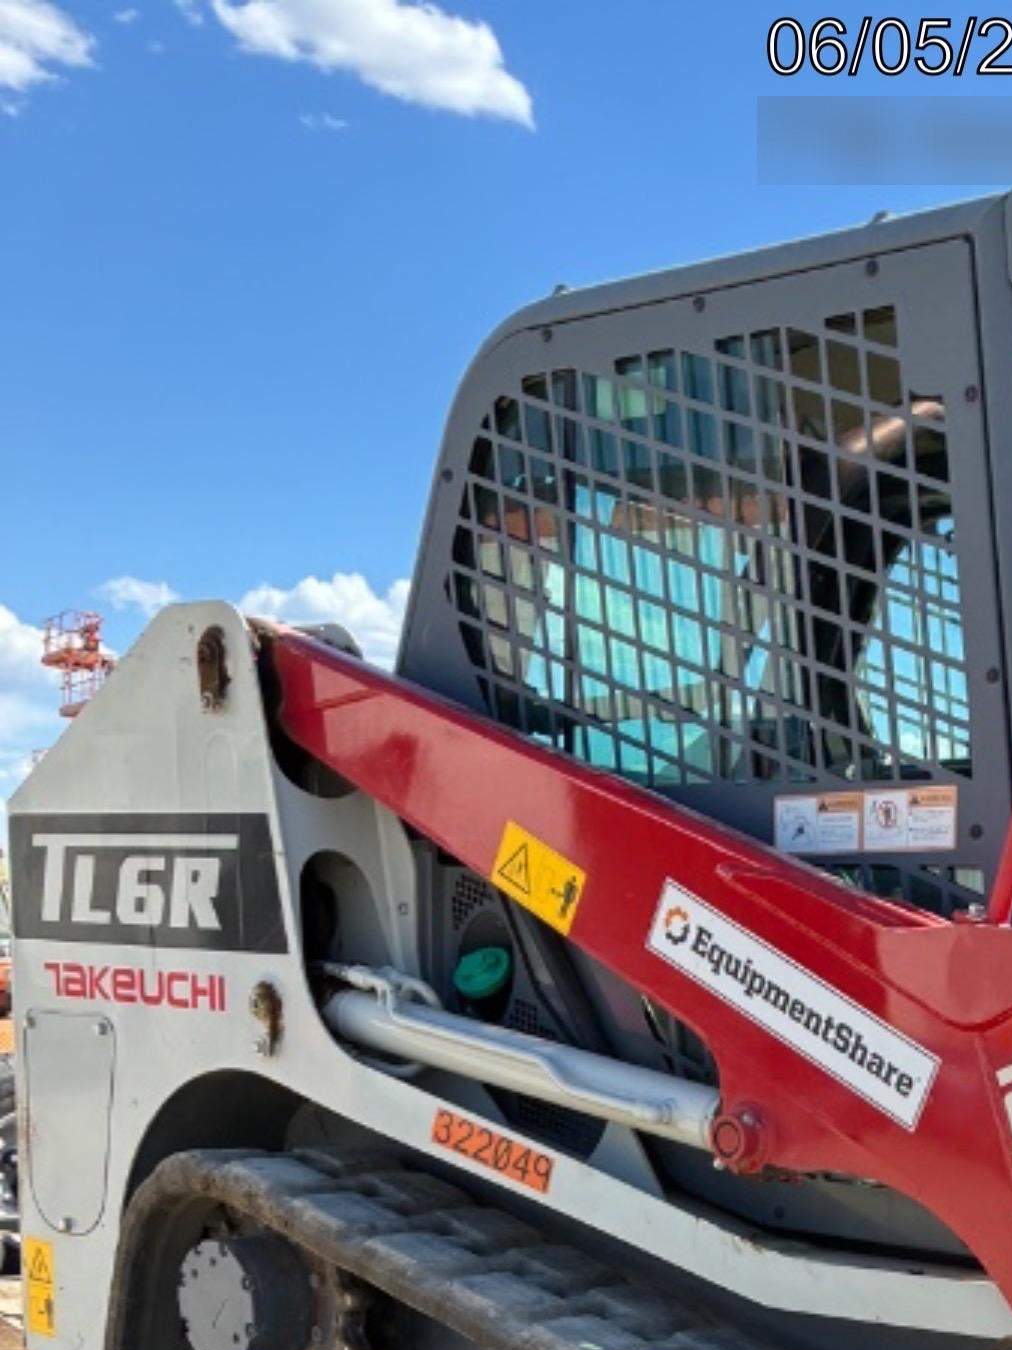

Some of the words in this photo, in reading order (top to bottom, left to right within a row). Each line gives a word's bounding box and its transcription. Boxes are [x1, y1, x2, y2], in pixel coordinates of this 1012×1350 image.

[32, 833, 239, 930] TL6R
[690, 926, 914, 1097] EquipmentShare
[433, 1109, 553, 1194] 322049
